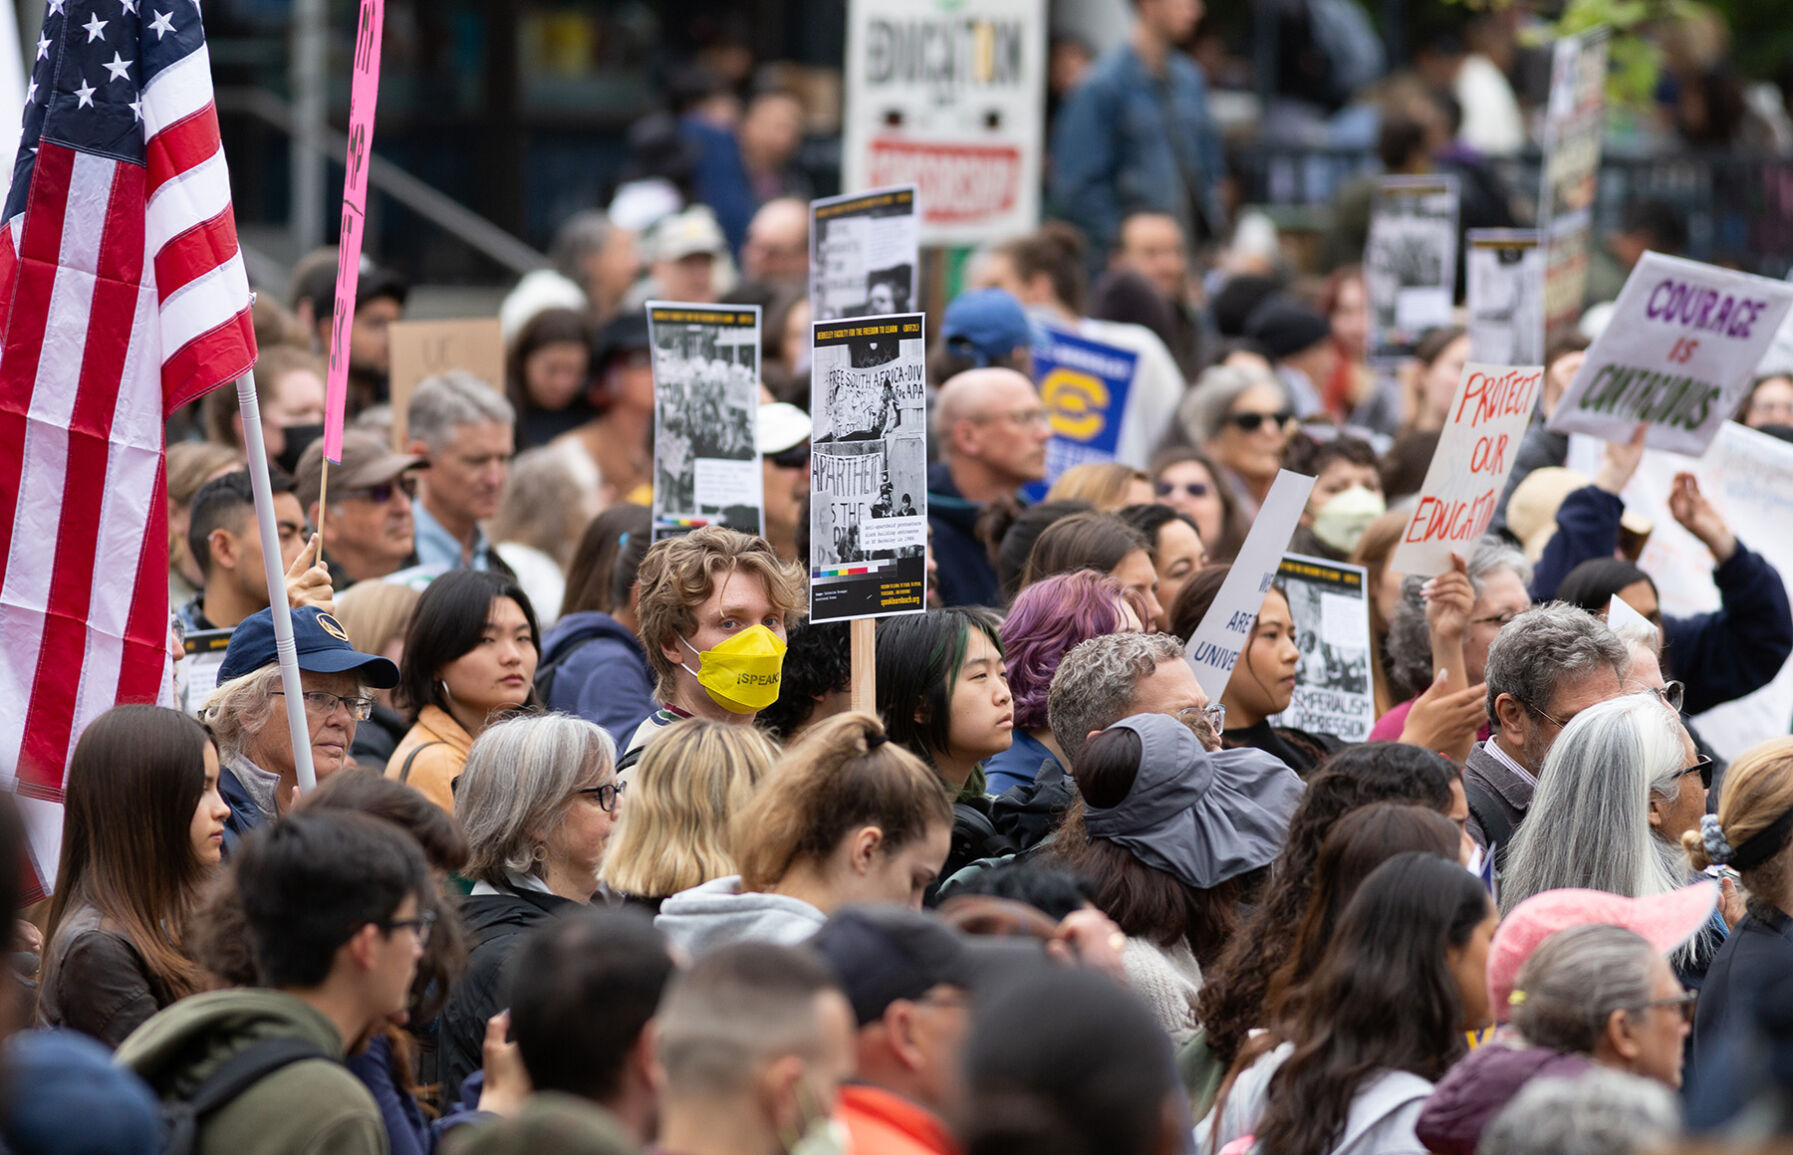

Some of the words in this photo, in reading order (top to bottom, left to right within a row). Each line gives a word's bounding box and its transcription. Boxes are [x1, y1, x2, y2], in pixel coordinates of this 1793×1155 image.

[1646, 277, 1768, 340] COURAGE
[1667, 337, 1699, 365] IS
[1454, 370, 1542, 428] PROTECT
[1470, 433, 1509, 476] OUR
[1225, 610, 1253, 634] ARE
